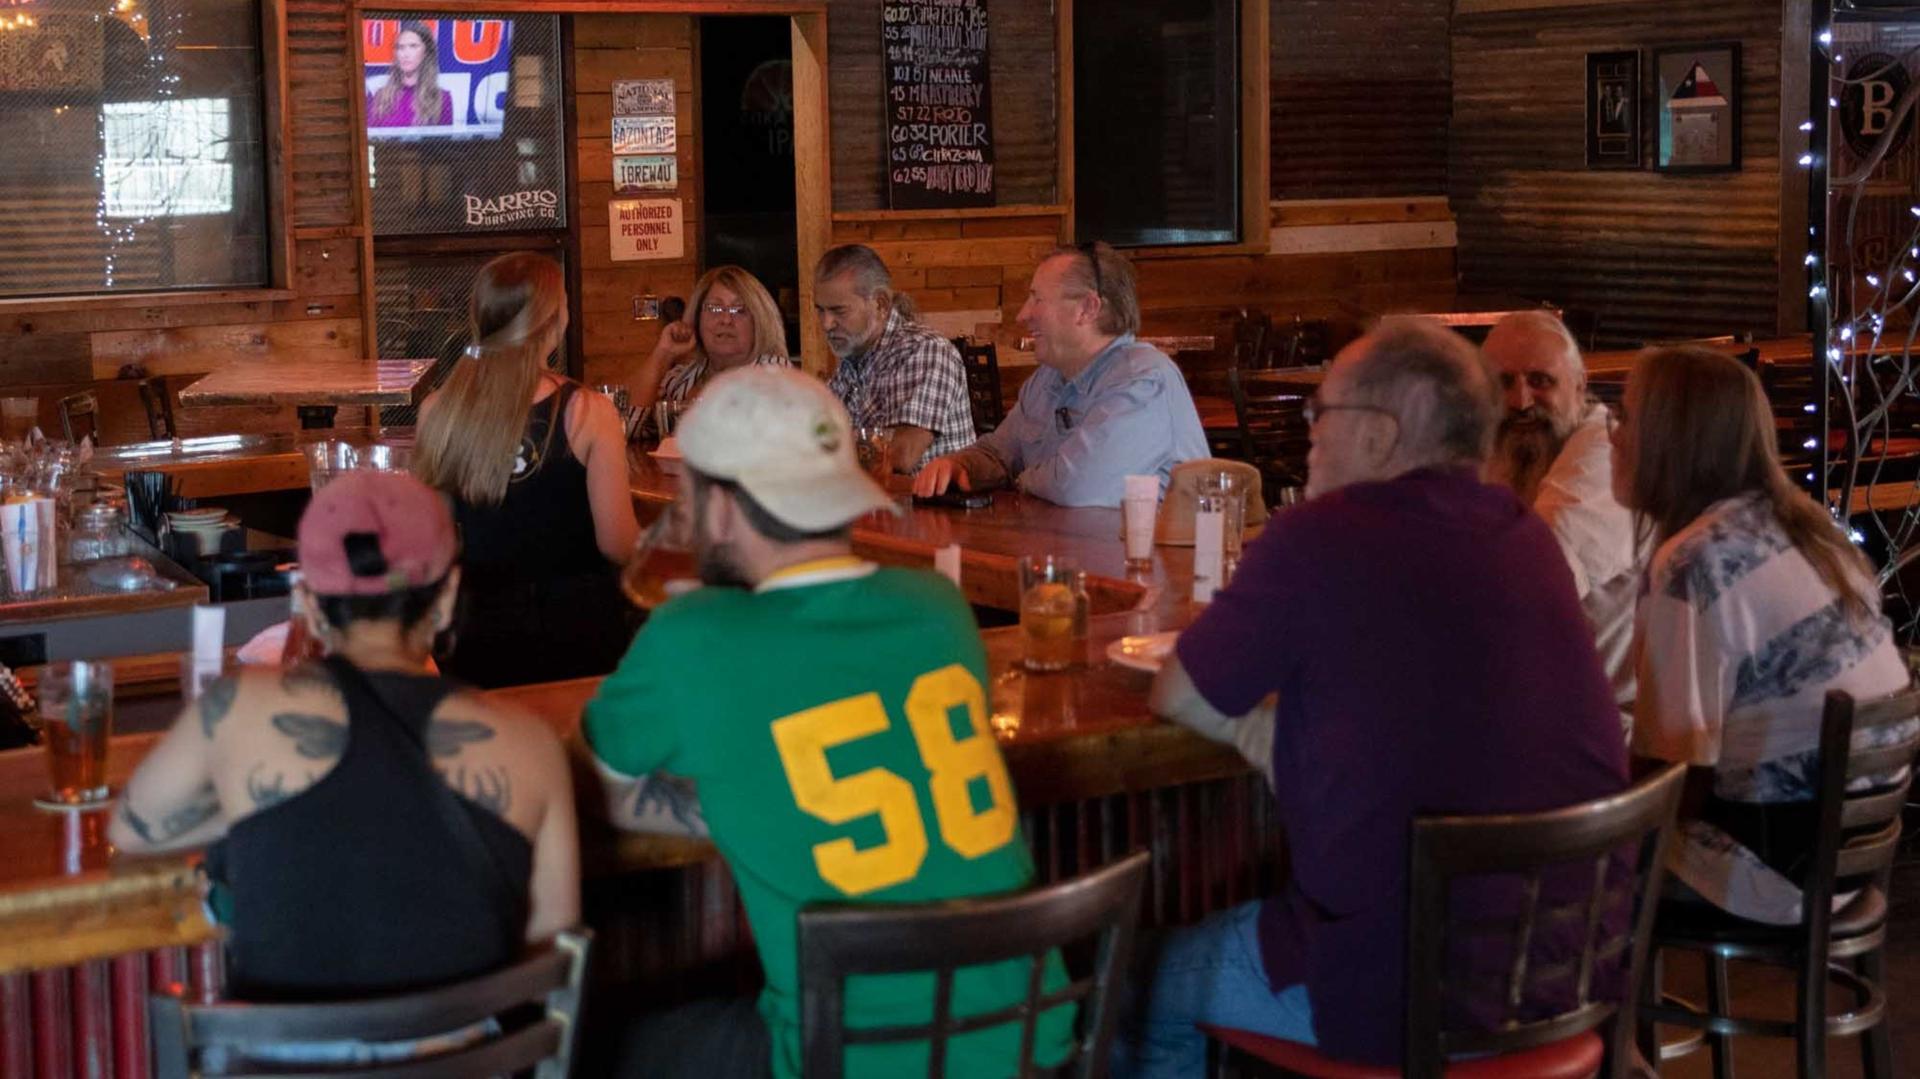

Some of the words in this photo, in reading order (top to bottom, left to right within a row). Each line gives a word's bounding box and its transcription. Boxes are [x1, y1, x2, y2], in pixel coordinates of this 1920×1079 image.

[617, 84, 670, 104] NATIONAL
[929, 122, 990, 146] PORTER
[620, 164, 672, 184] IBREW4U
[464, 189, 557, 225] BARRIO
[619, 205, 673, 221] AUTHORIZED
[621, 222, 673, 237] PERSONNEL
[635, 238, 660, 252] ONLY
[770, 663, 1018, 897] 58
